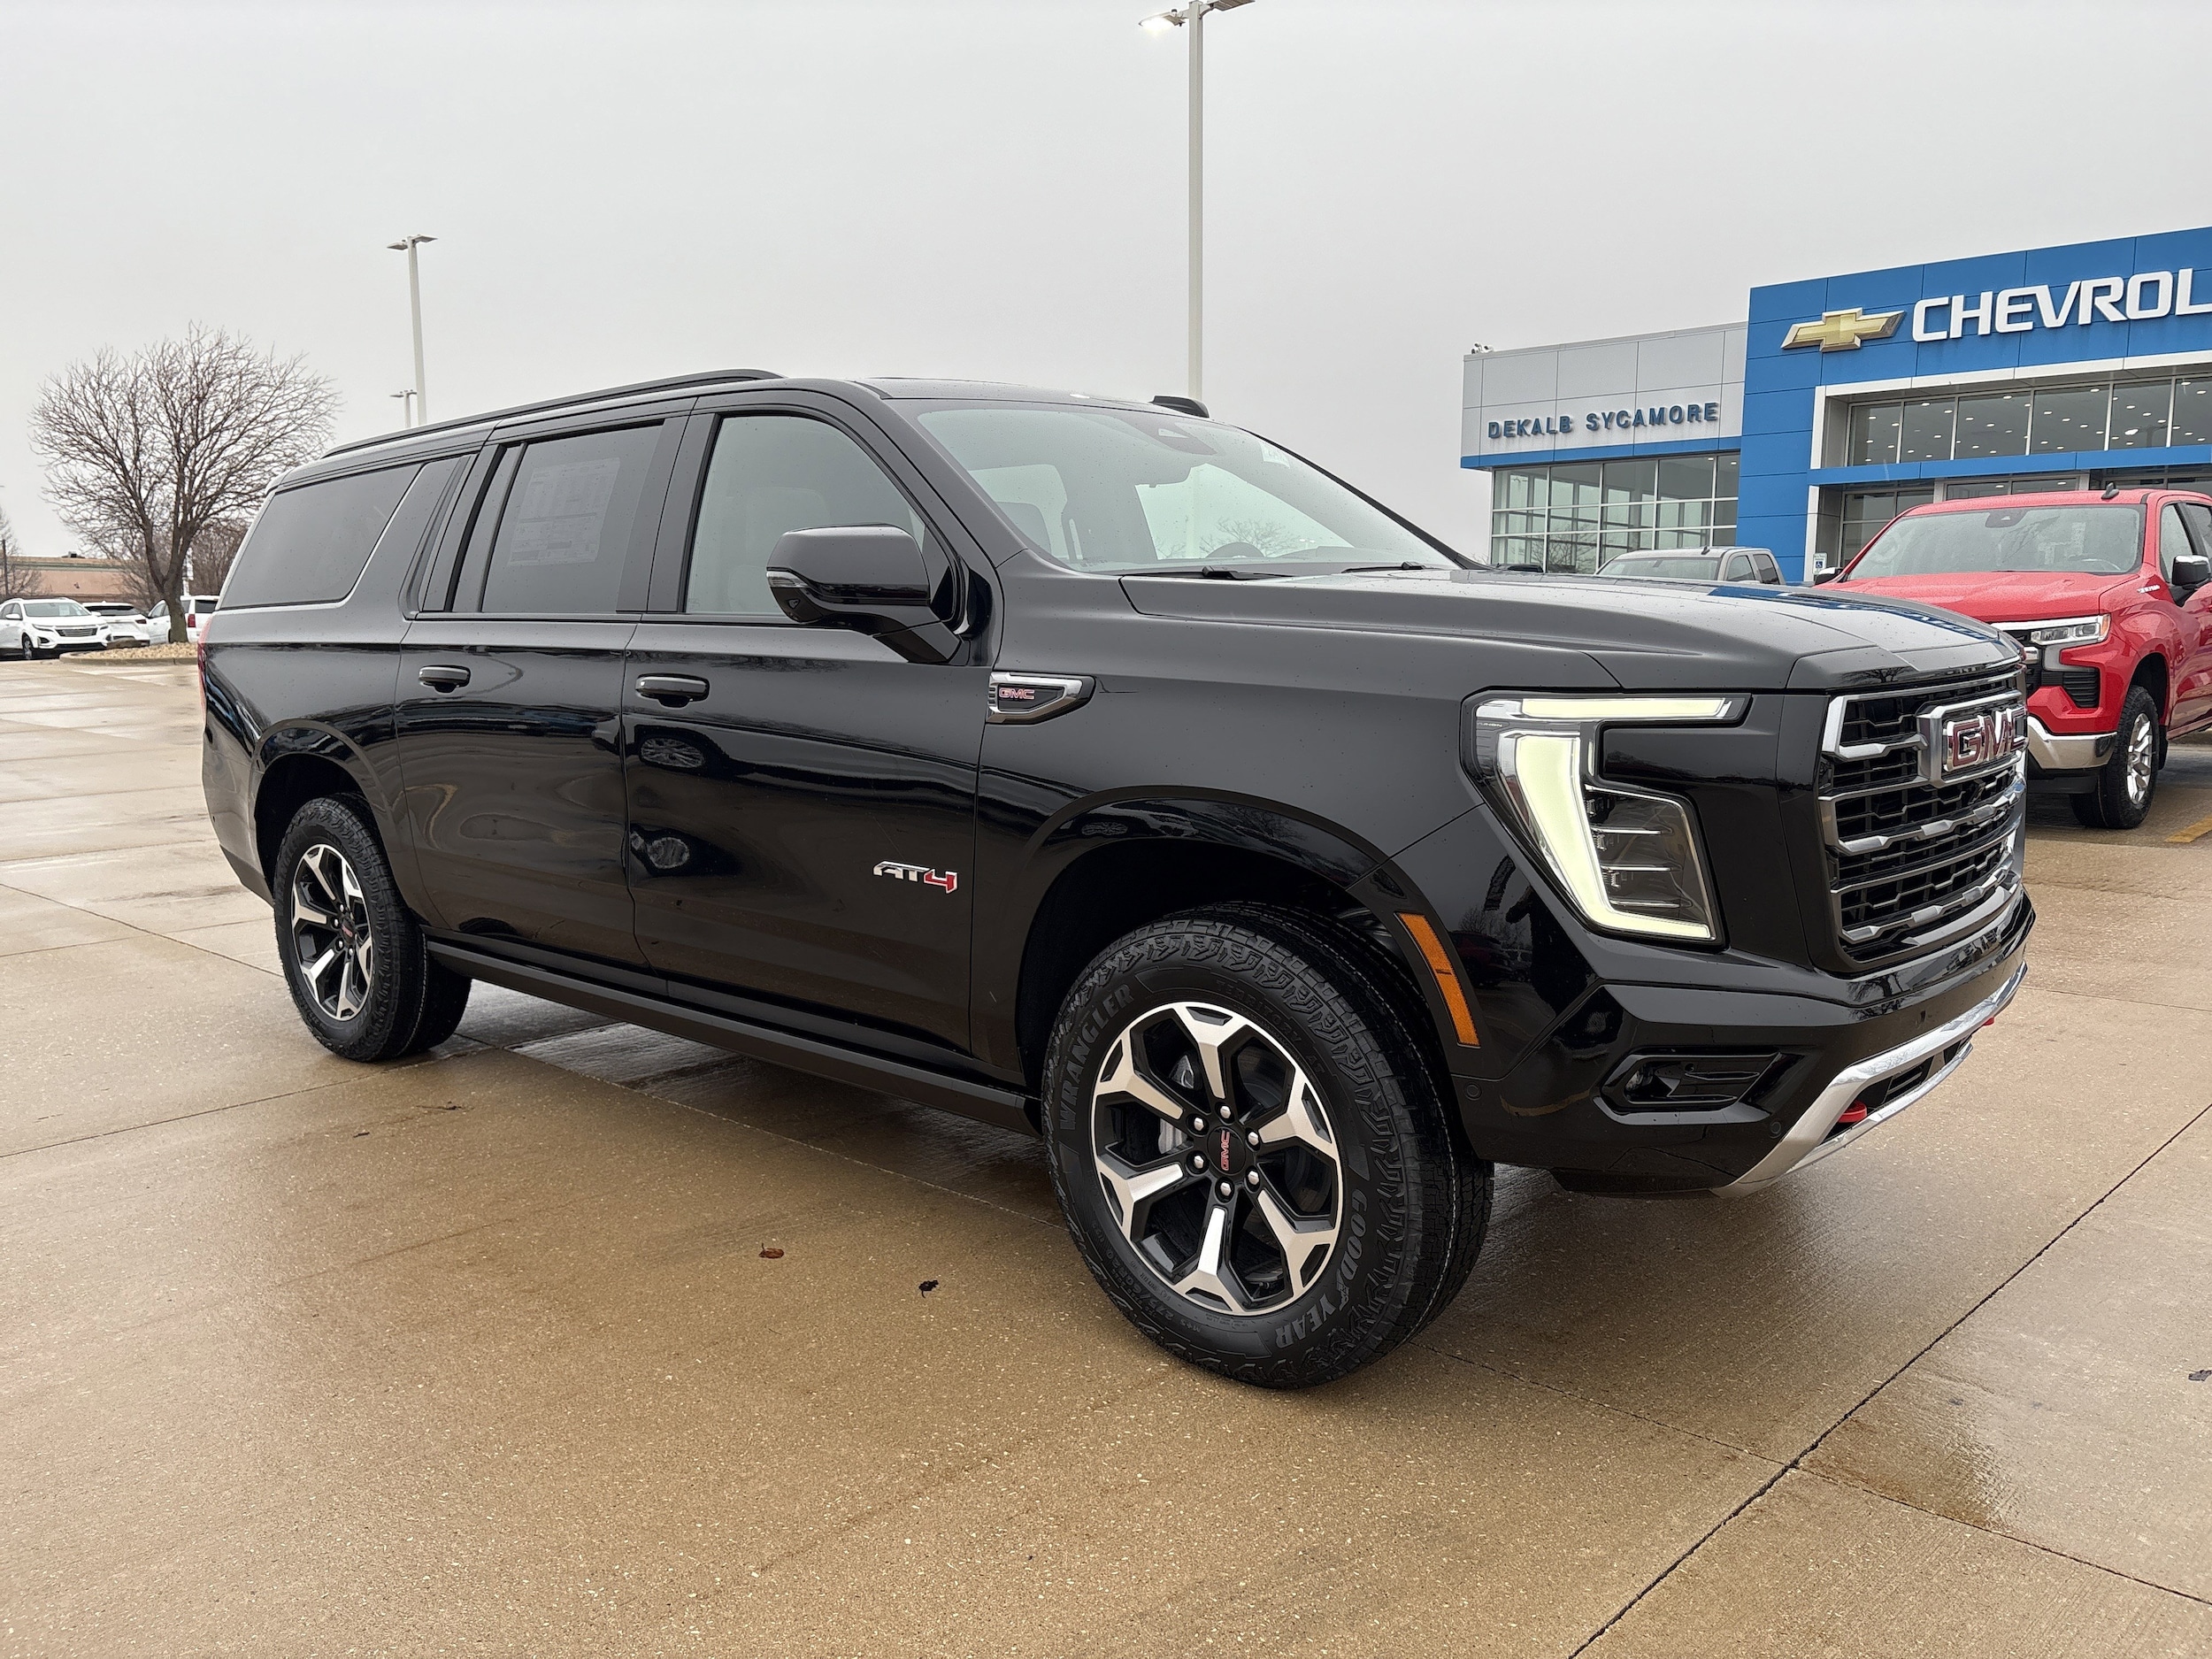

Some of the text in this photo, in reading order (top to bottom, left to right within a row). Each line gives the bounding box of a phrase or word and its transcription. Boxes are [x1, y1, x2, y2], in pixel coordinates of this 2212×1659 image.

[1912, 267, 2212, 342] CHEVROL
[1488, 402, 1719, 438] DEKALB SYCAMORE
[999, 687, 1035, 700] GMC
[1947, 706, 2027, 772] GMC
[873, 860, 958, 894] AT4
[1060, 984, 1134, 1131] WRANGLER
[1221, 1129, 1230, 1171] GMC
